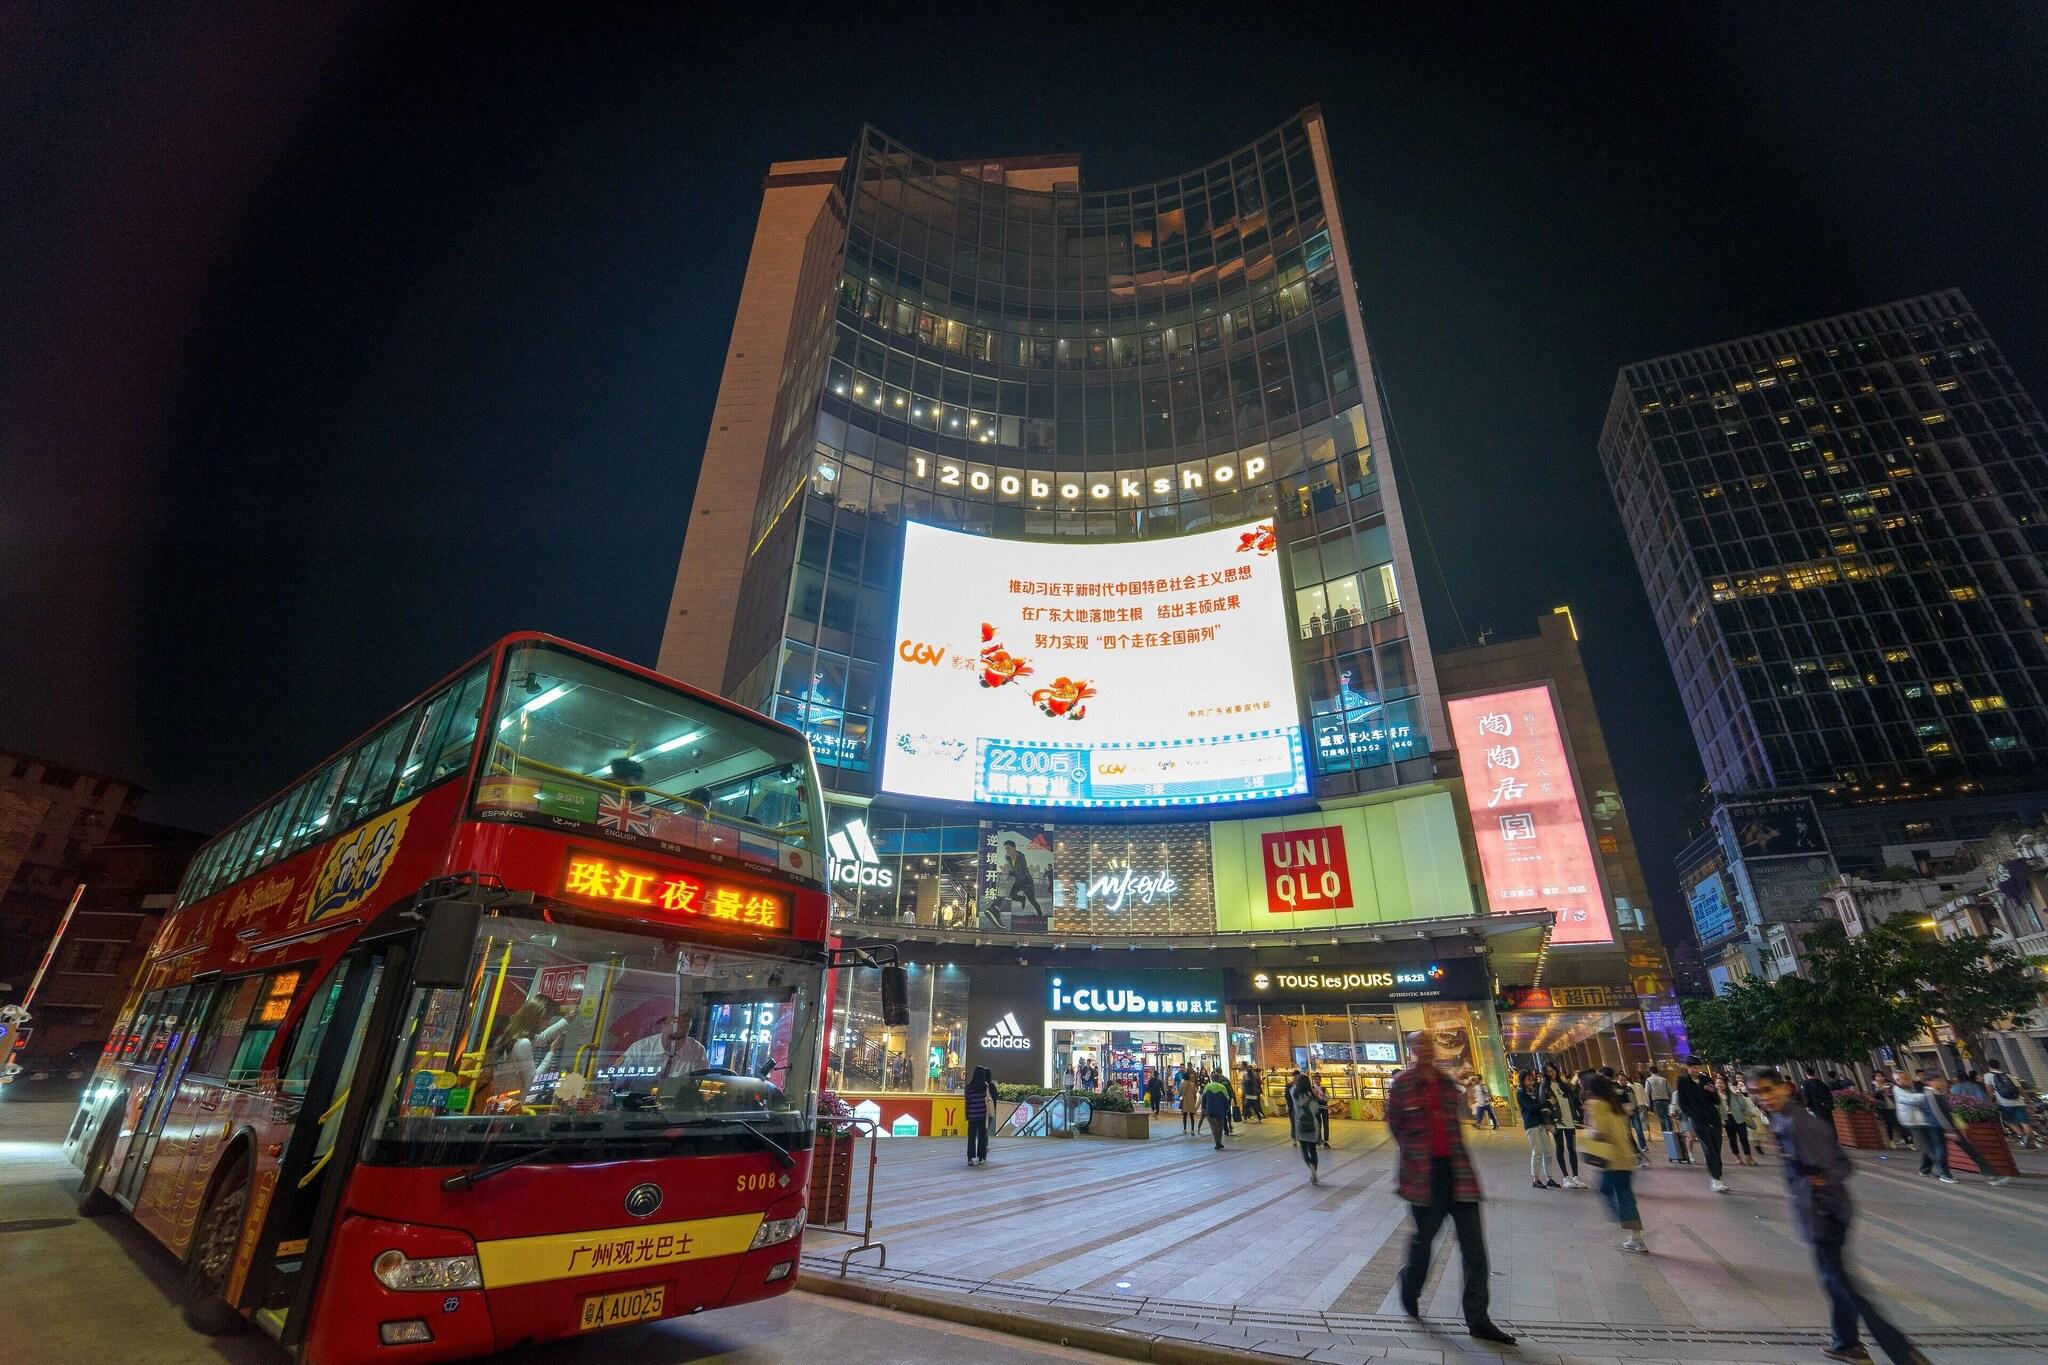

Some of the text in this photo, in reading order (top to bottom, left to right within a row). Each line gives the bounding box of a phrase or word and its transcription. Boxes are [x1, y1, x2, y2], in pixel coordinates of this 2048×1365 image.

[915, 456, 1266, 499] 1200bookshop
[1008, 564, 1253, 597] 推动习近平新时代中国特色社会主义思想
[1021, 594, 1242, 623] 在广东大地落地生根 结出丰硕成果
[899, 639, 945, 666] CGV
[1187, 700, 1271, 718] 中共广东省委宣传部
[990, 749, 1070, 773] 22:00后
[1478, 712, 1529, 808] 陶陶居
[481, 810, 527, 819] ESPAÑOL
[604, 828, 638, 841] ENGLISH
[1271, 837, 1331, 868] UNI
[985, 834, 999, 903] 逆境开练
[566, 862, 776, 928] 珠江夜景线
[1276, 870, 1341, 906] QLO
[1277, 972, 1394, 990] TOUS les JOURS
[980, 1034, 1031, 1049] adidas
[736, 1171, 776, 1192] S008
[567, 1232, 694, 1272] 广州观光巴士
